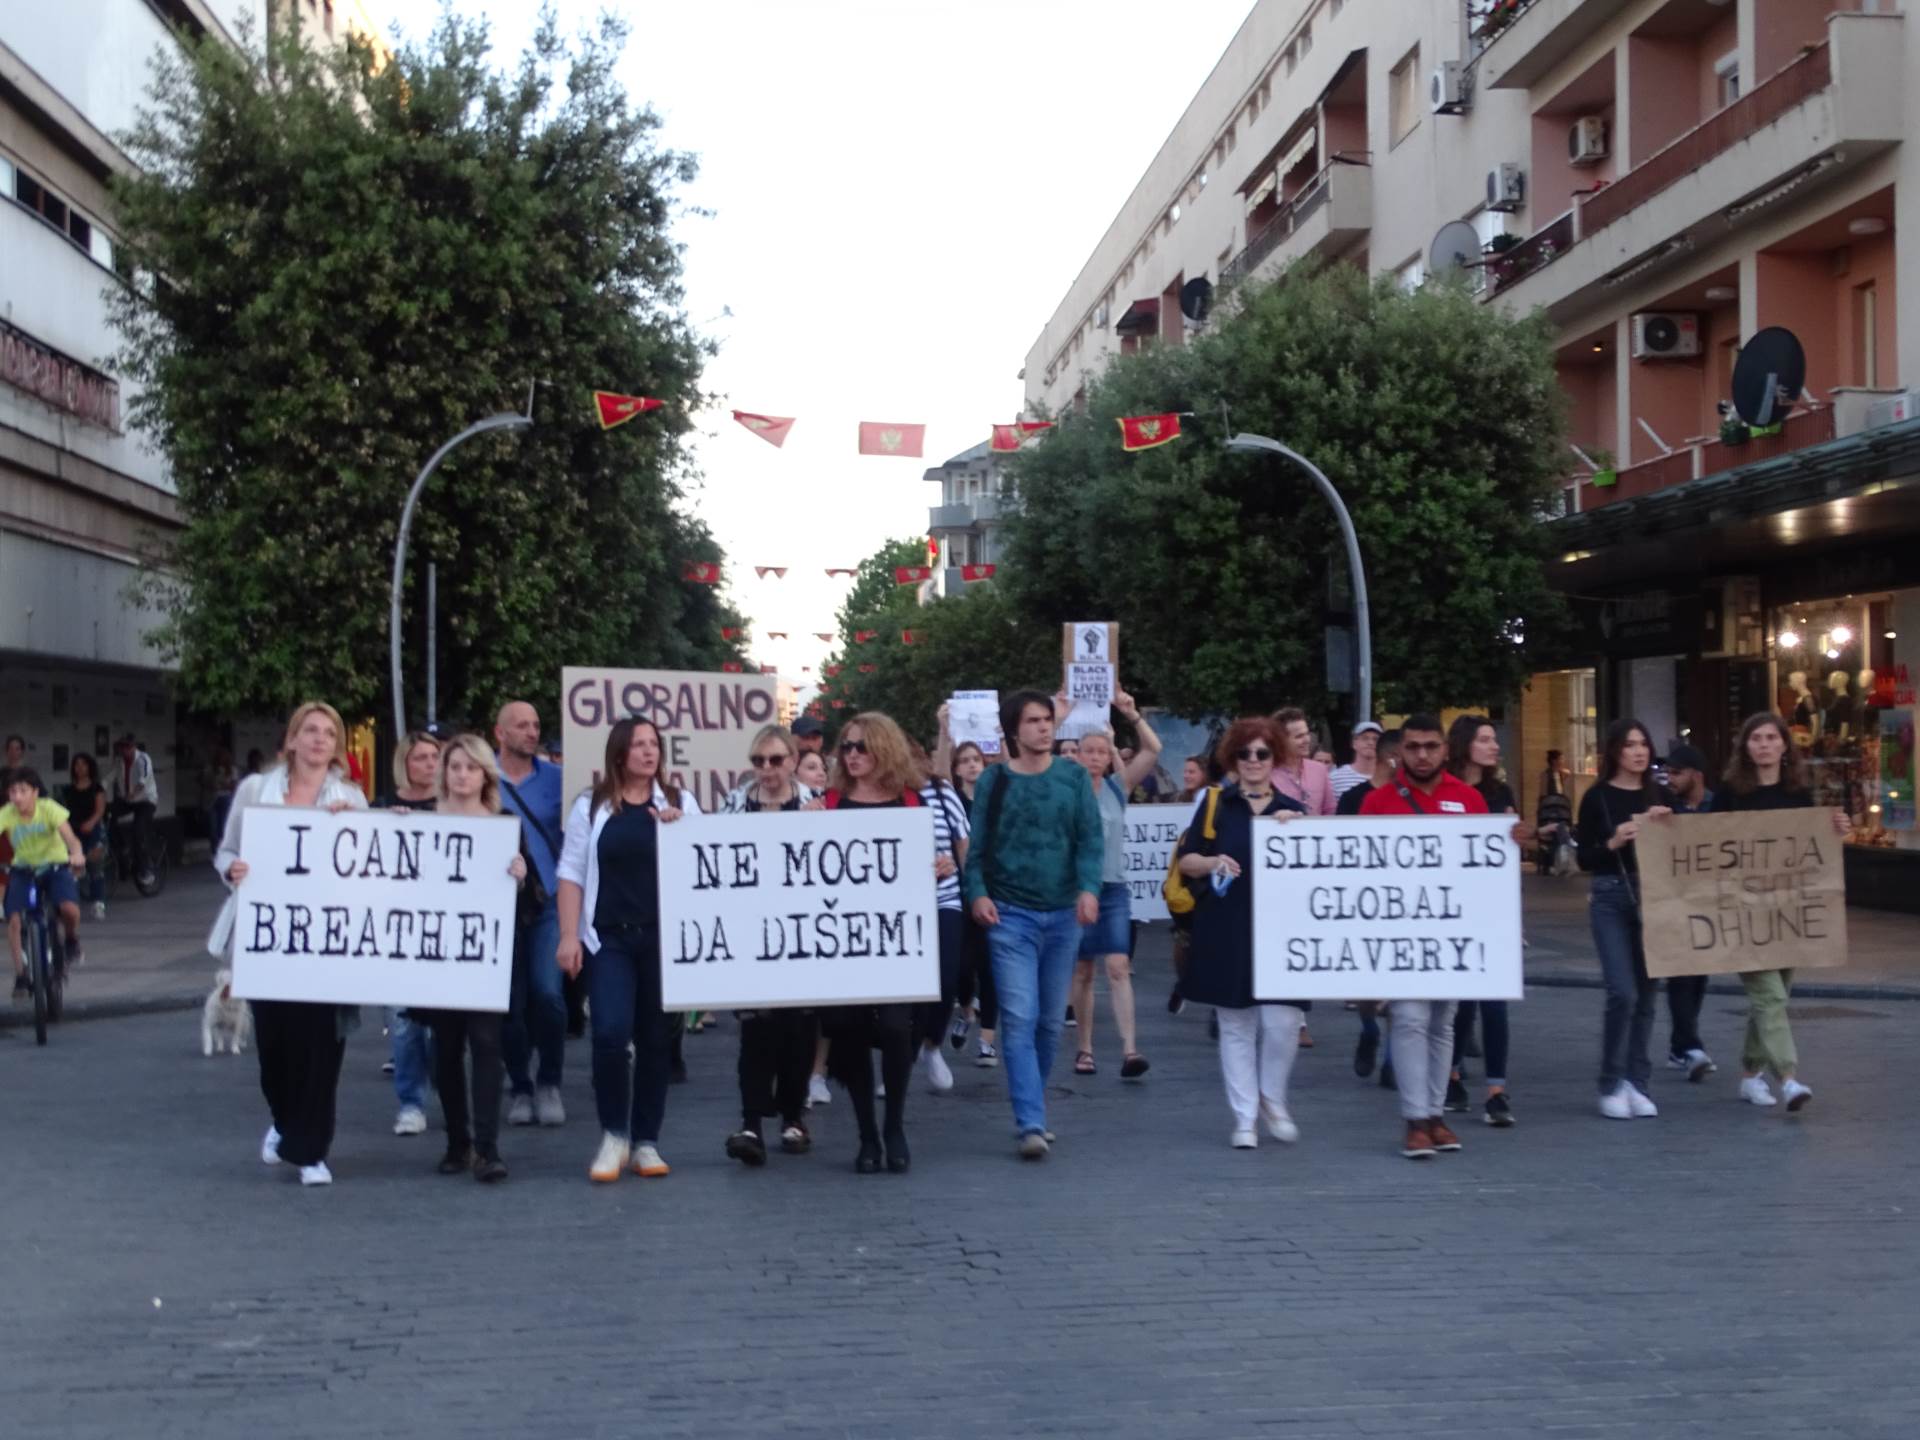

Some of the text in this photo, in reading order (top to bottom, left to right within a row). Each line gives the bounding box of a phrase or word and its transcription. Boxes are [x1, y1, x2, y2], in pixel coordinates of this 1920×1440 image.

[568, 679, 774, 731] GLOBALNO
[1073, 683, 1108, 693] LIVES
[660, 736, 690, 765] E
[285, 825, 473, 883] I CAN'T
[692, 838, 902, 890] NE MOGU
[1265, 833, 1507, 870] SILENCE IS
[1309, 885, 1462, 921] GLOBAL
[245, 902, 499, 964] BREATHE!
[673, 898, 923, 964] DA DIŠEM!
[1688, 904, 1828, 951] DHUNE
[1286, 937, 1486, 973] SLAVERY!
